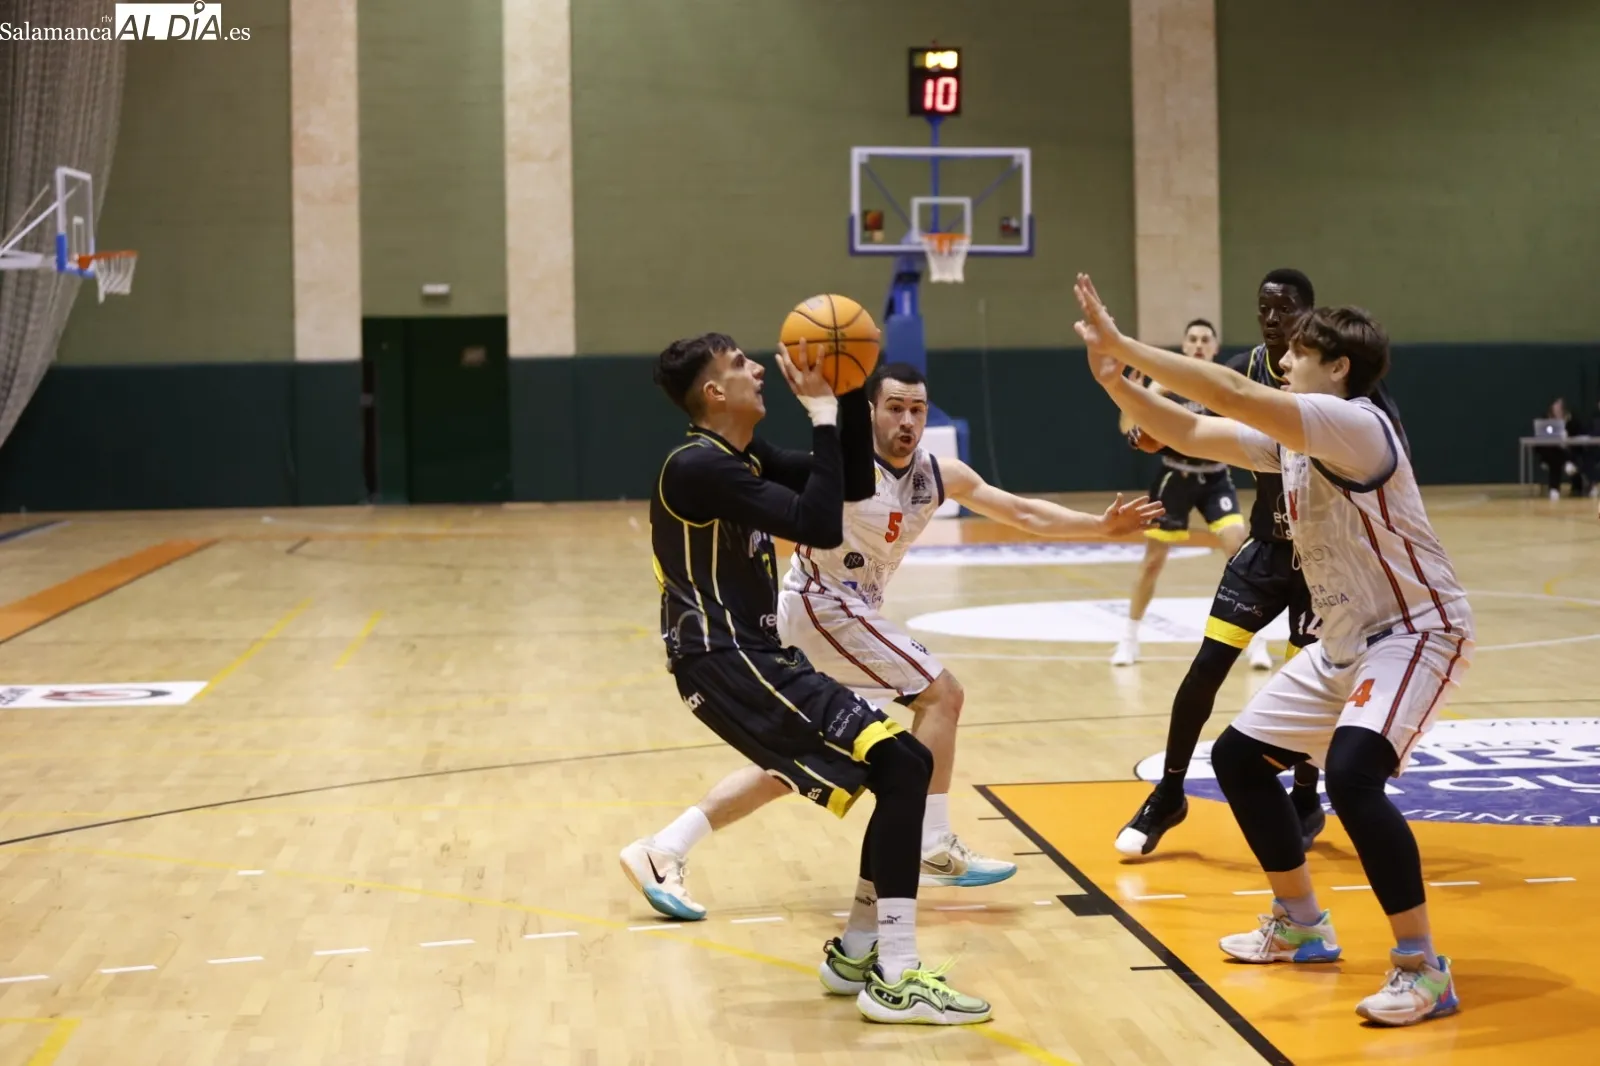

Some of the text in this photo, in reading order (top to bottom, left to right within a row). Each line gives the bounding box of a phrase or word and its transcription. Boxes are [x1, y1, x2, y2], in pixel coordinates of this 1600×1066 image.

[924, 76, 958, 112] 10
[885, 511, 903, 543] 5
[1347, 678, 1375, 708] 4
